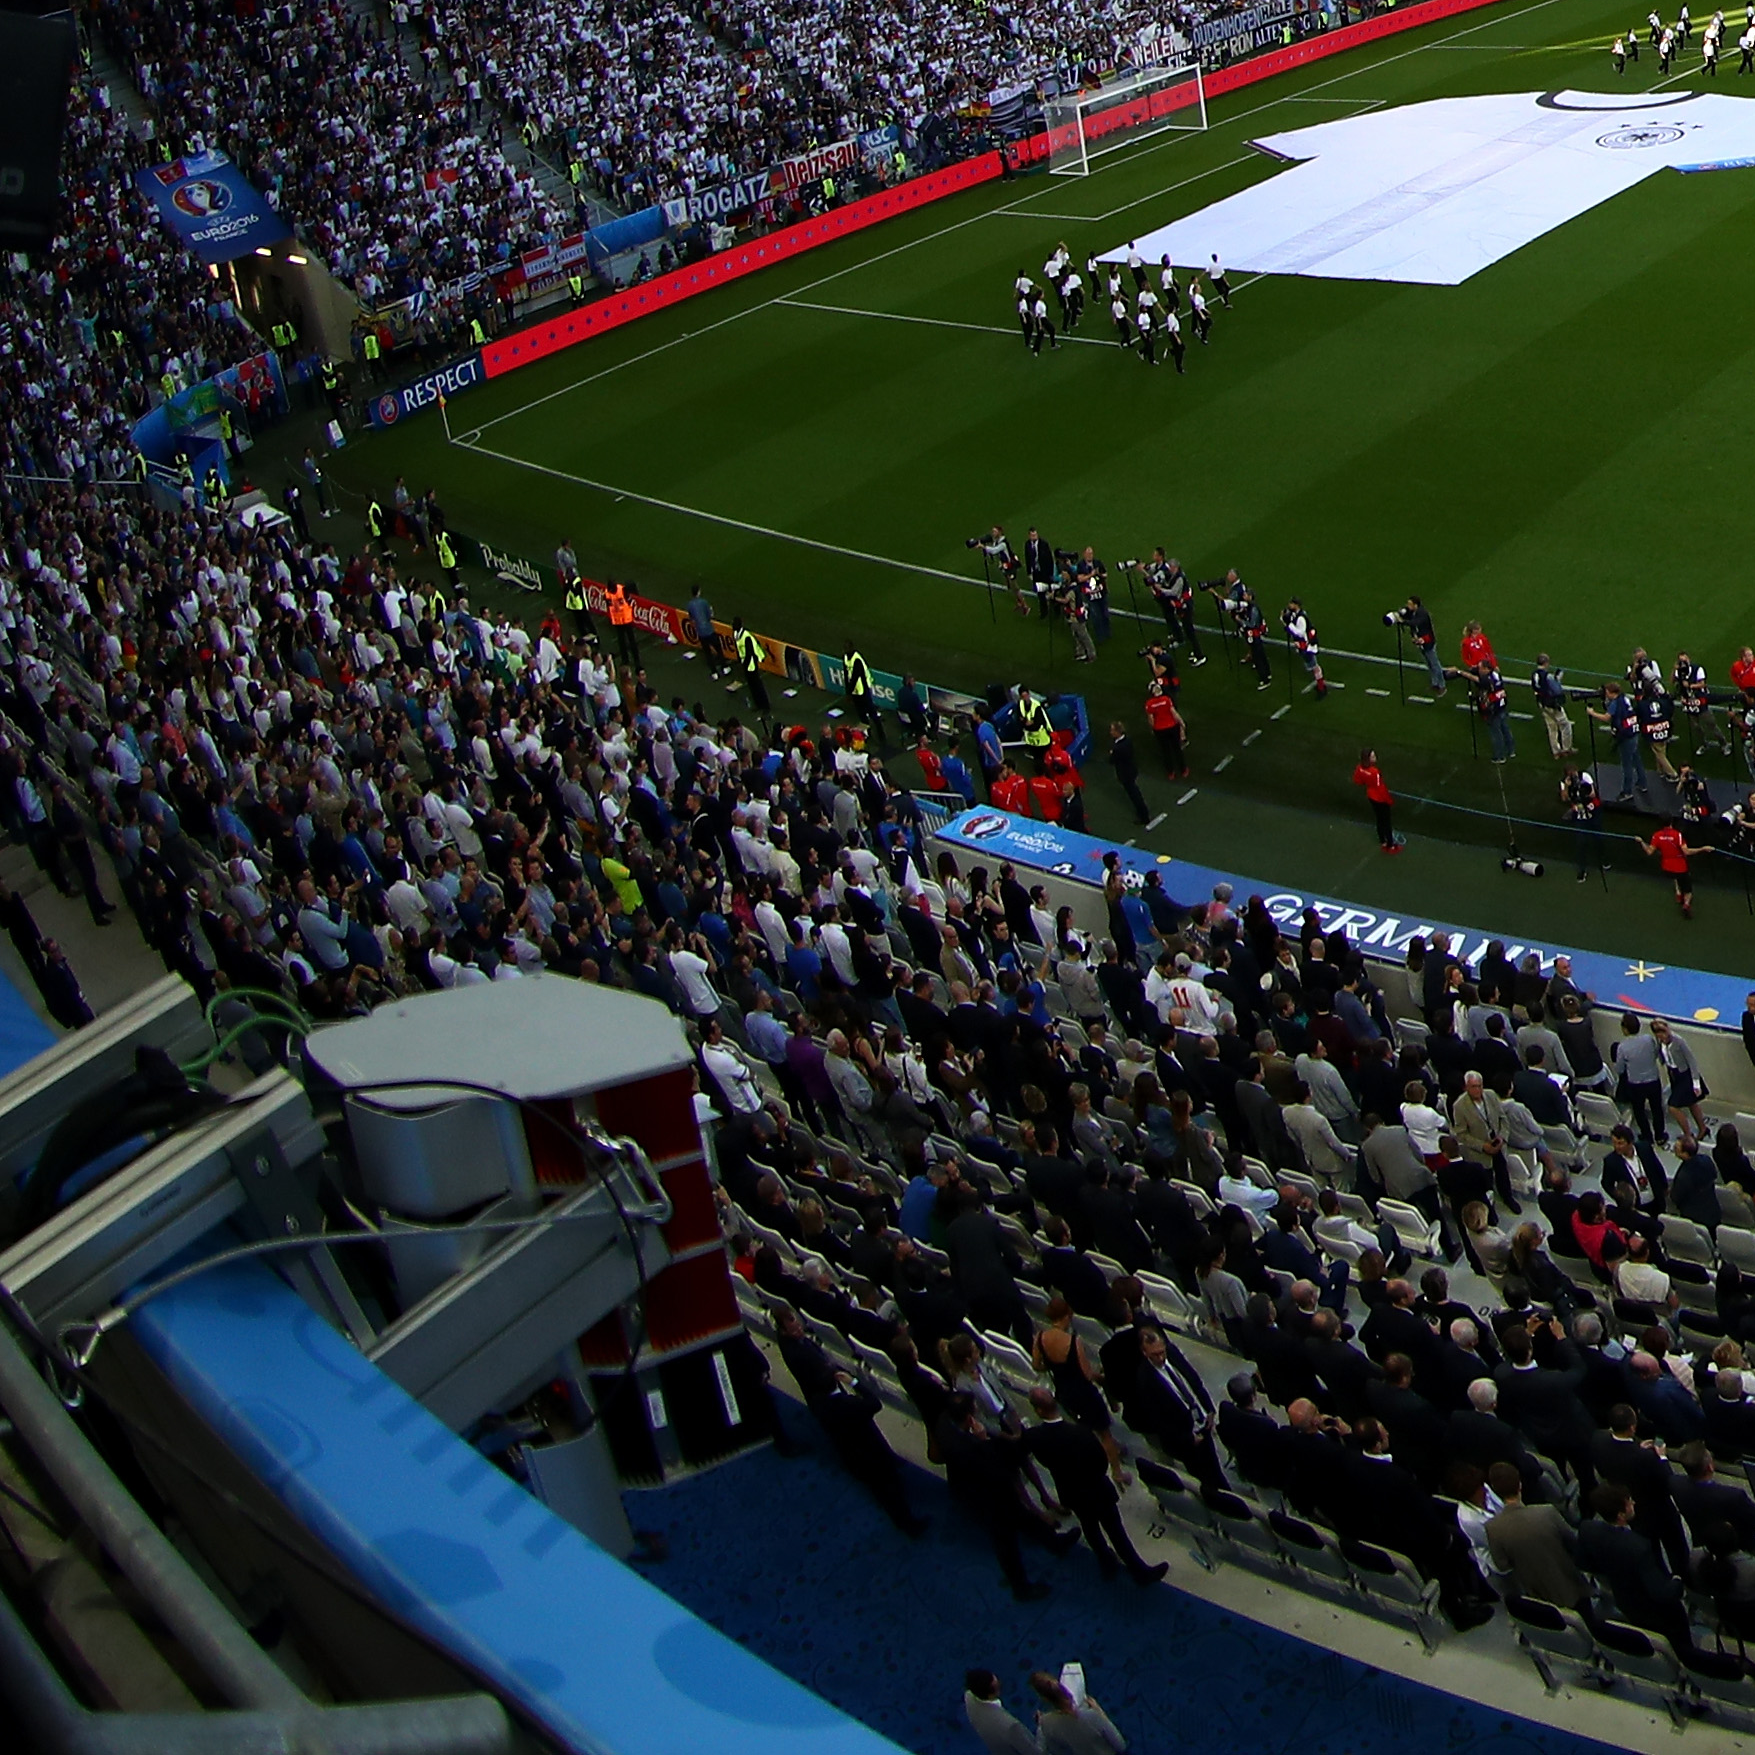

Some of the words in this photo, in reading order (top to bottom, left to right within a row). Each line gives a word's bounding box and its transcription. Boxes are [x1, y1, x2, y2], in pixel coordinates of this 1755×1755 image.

[190, 213, 260, 243] EURO2016
[401, 357, 478, 413] RESPECT
[479, 543, 544, 592] Probably
[1172, 987, 1189, 1008] 11
